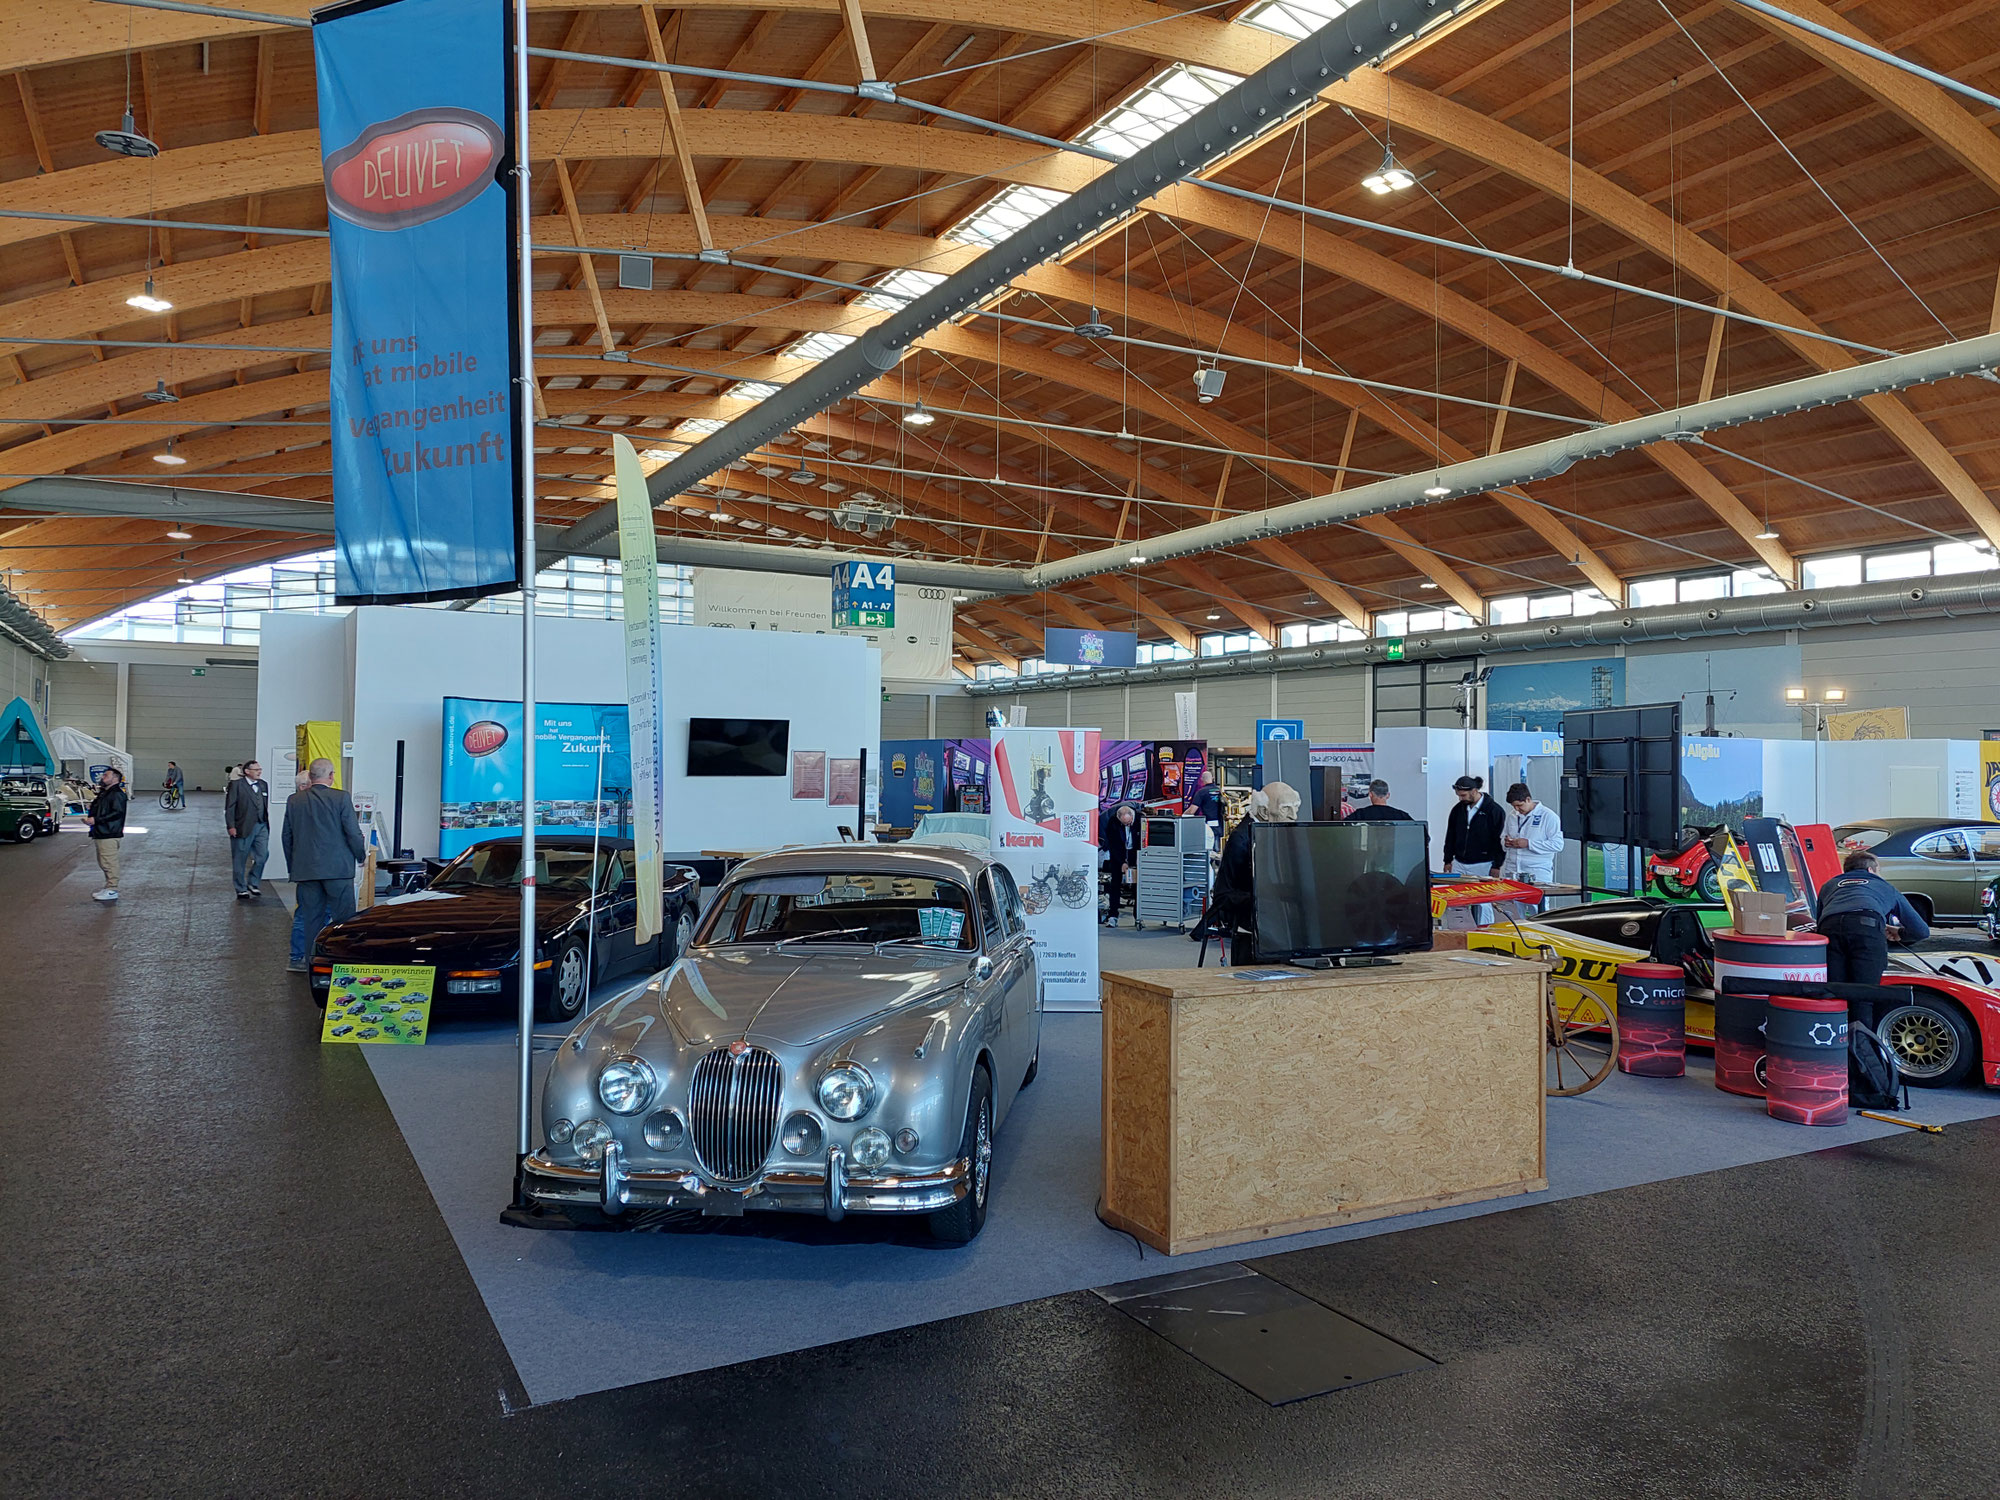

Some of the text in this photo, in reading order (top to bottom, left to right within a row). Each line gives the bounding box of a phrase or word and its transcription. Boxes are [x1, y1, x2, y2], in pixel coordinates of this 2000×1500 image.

[363, 138, 464, 200] DEUVET
[372, 334, 419, 355] uns
[363, 352, 477, 388] at mobile
[851, 563, 894, 591] A4
[708, 604, 827, 619] Willkommen bei Freunden
[861, 601, 873, 609] A1
[880, 602, 891, 611] A7
[544, 719, 557, 727] Mit
[468, 729, 496, 749] DEUVET
[1686, 743, 1721, 761] Allgäu
[334, 965, 350, 974] Uns
[351, 966, 371, 974] kann
[391, 967, 433, 976] gewinnen!
